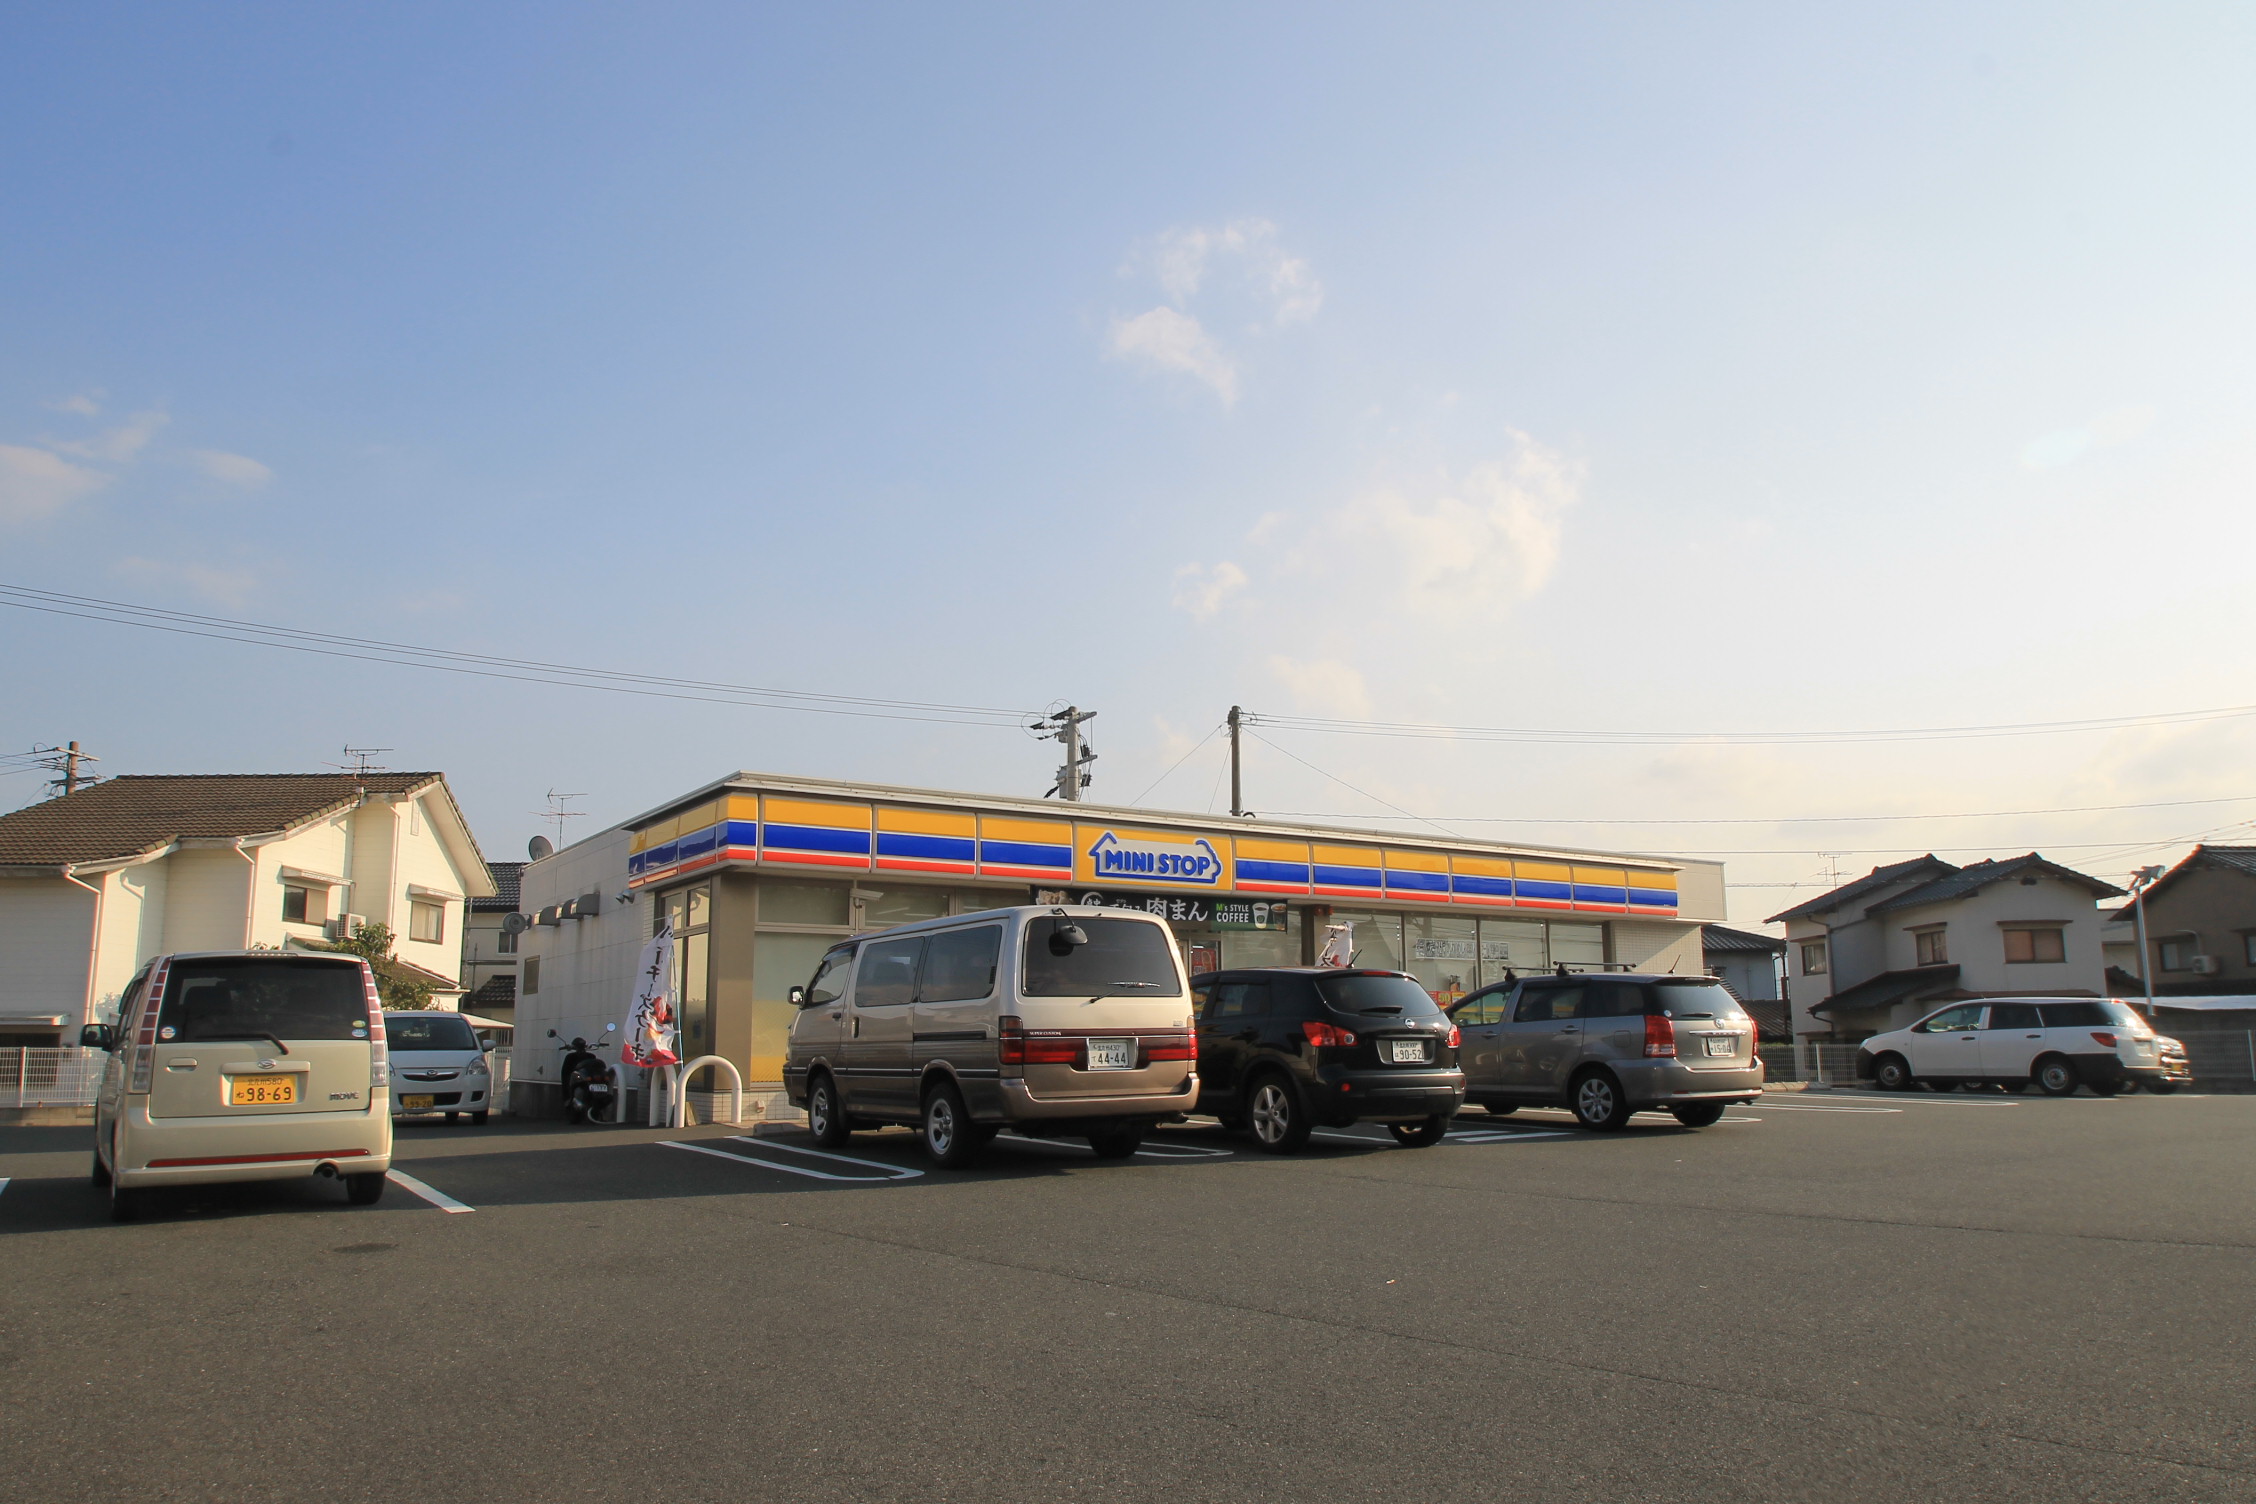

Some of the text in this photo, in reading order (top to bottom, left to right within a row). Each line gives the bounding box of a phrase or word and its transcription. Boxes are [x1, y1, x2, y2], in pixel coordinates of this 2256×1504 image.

[1105, 849, 1211, 876] MINI STOP
[1146, 897, 1209, 921] 肉まん
[1216, 903, 1249, 912] M's STYLE
[1216, 912, 1249, 923] COFFEE
[1098, 1052, 1126, 1064] 44-44
[1400, 1049, 1422, 1060] 90-52
[247, 1086, 292, 1102] 98-69
